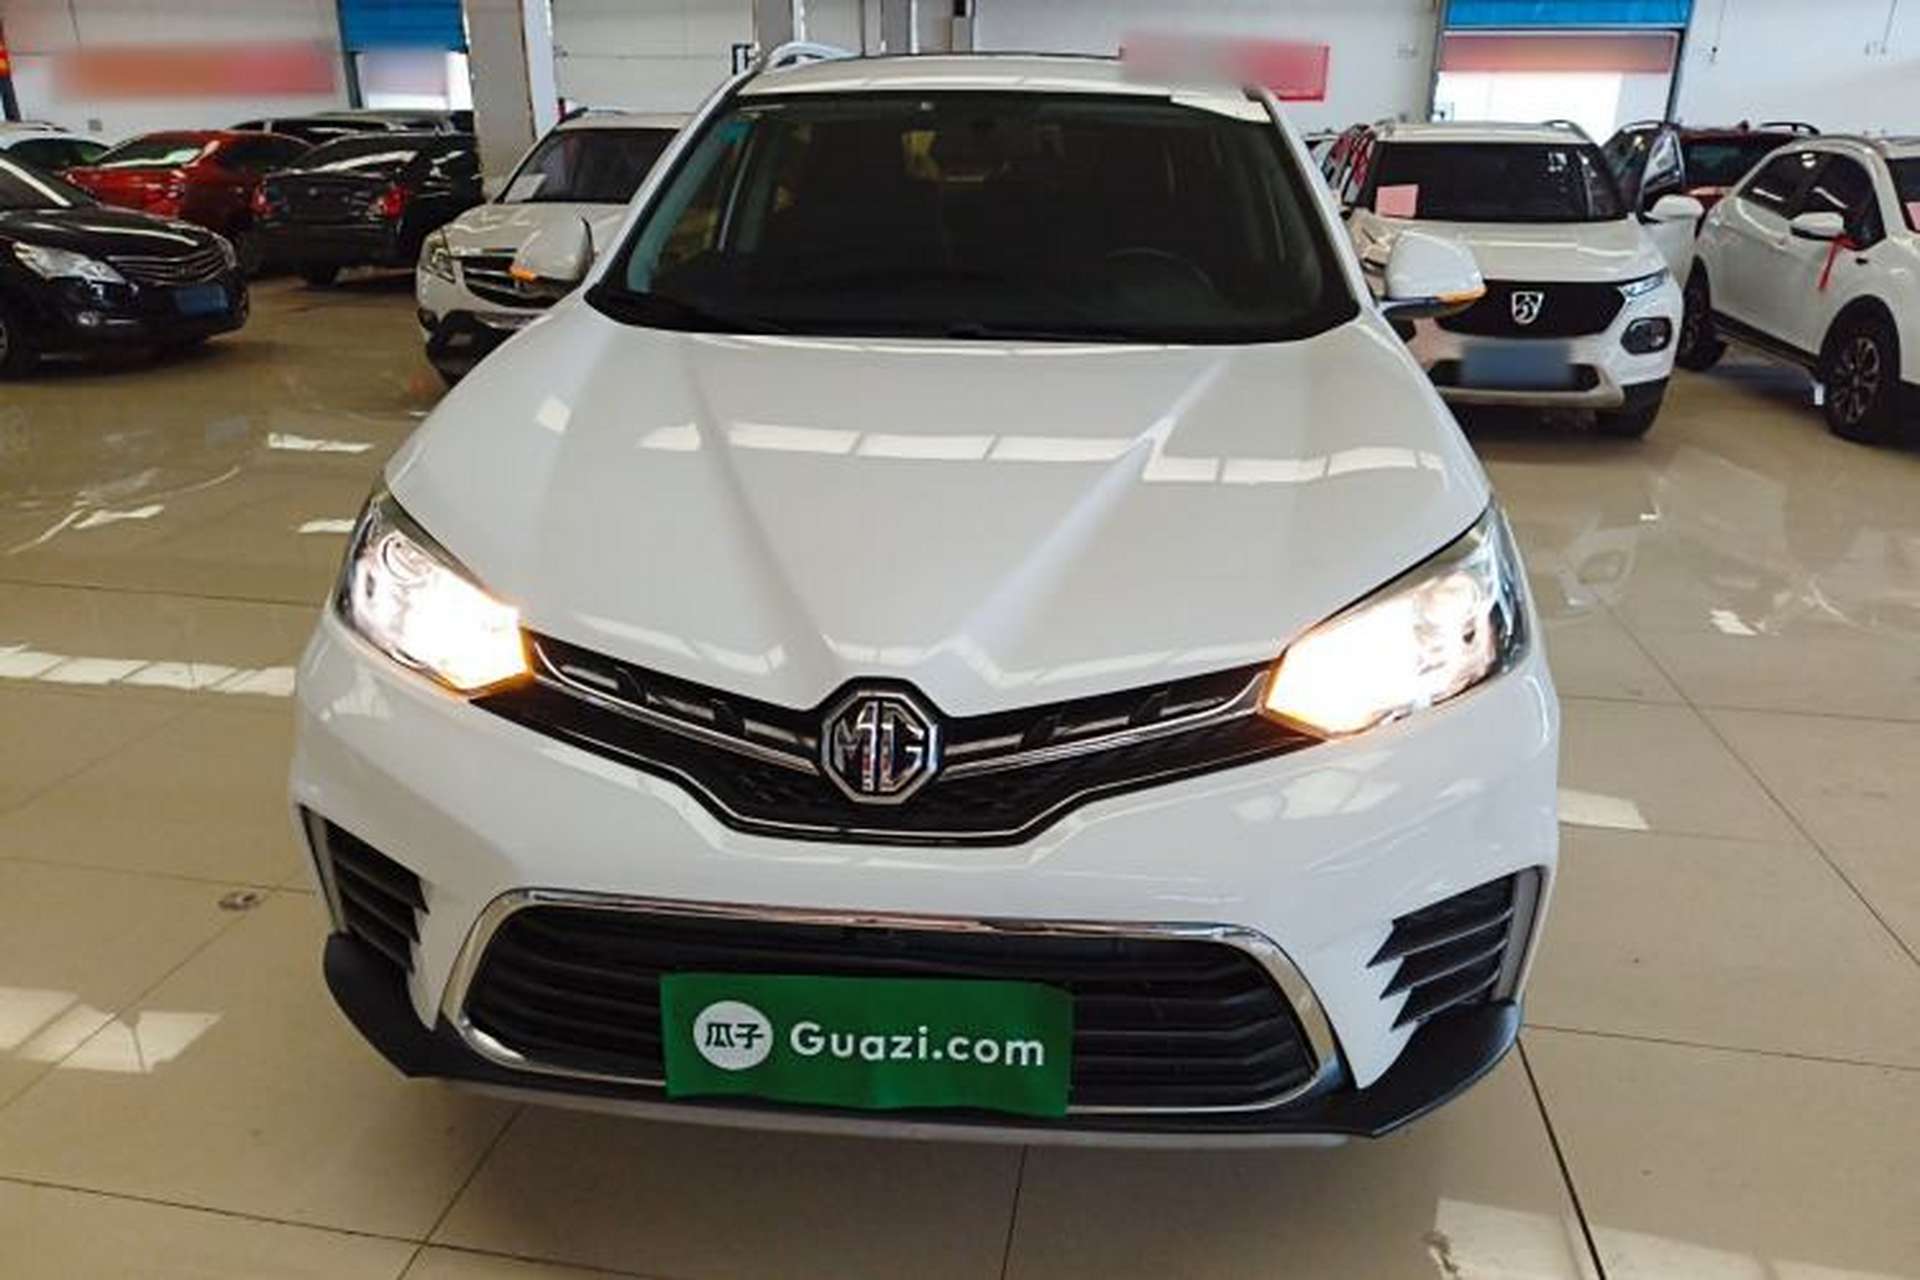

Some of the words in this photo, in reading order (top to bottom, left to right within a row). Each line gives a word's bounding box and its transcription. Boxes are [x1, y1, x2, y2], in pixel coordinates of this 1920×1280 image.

[833, 700, 925, 792] MG
[705, 1022, 764, 1049] 瓜子
[790, 1020, 1045, 1067] Guazi.com
